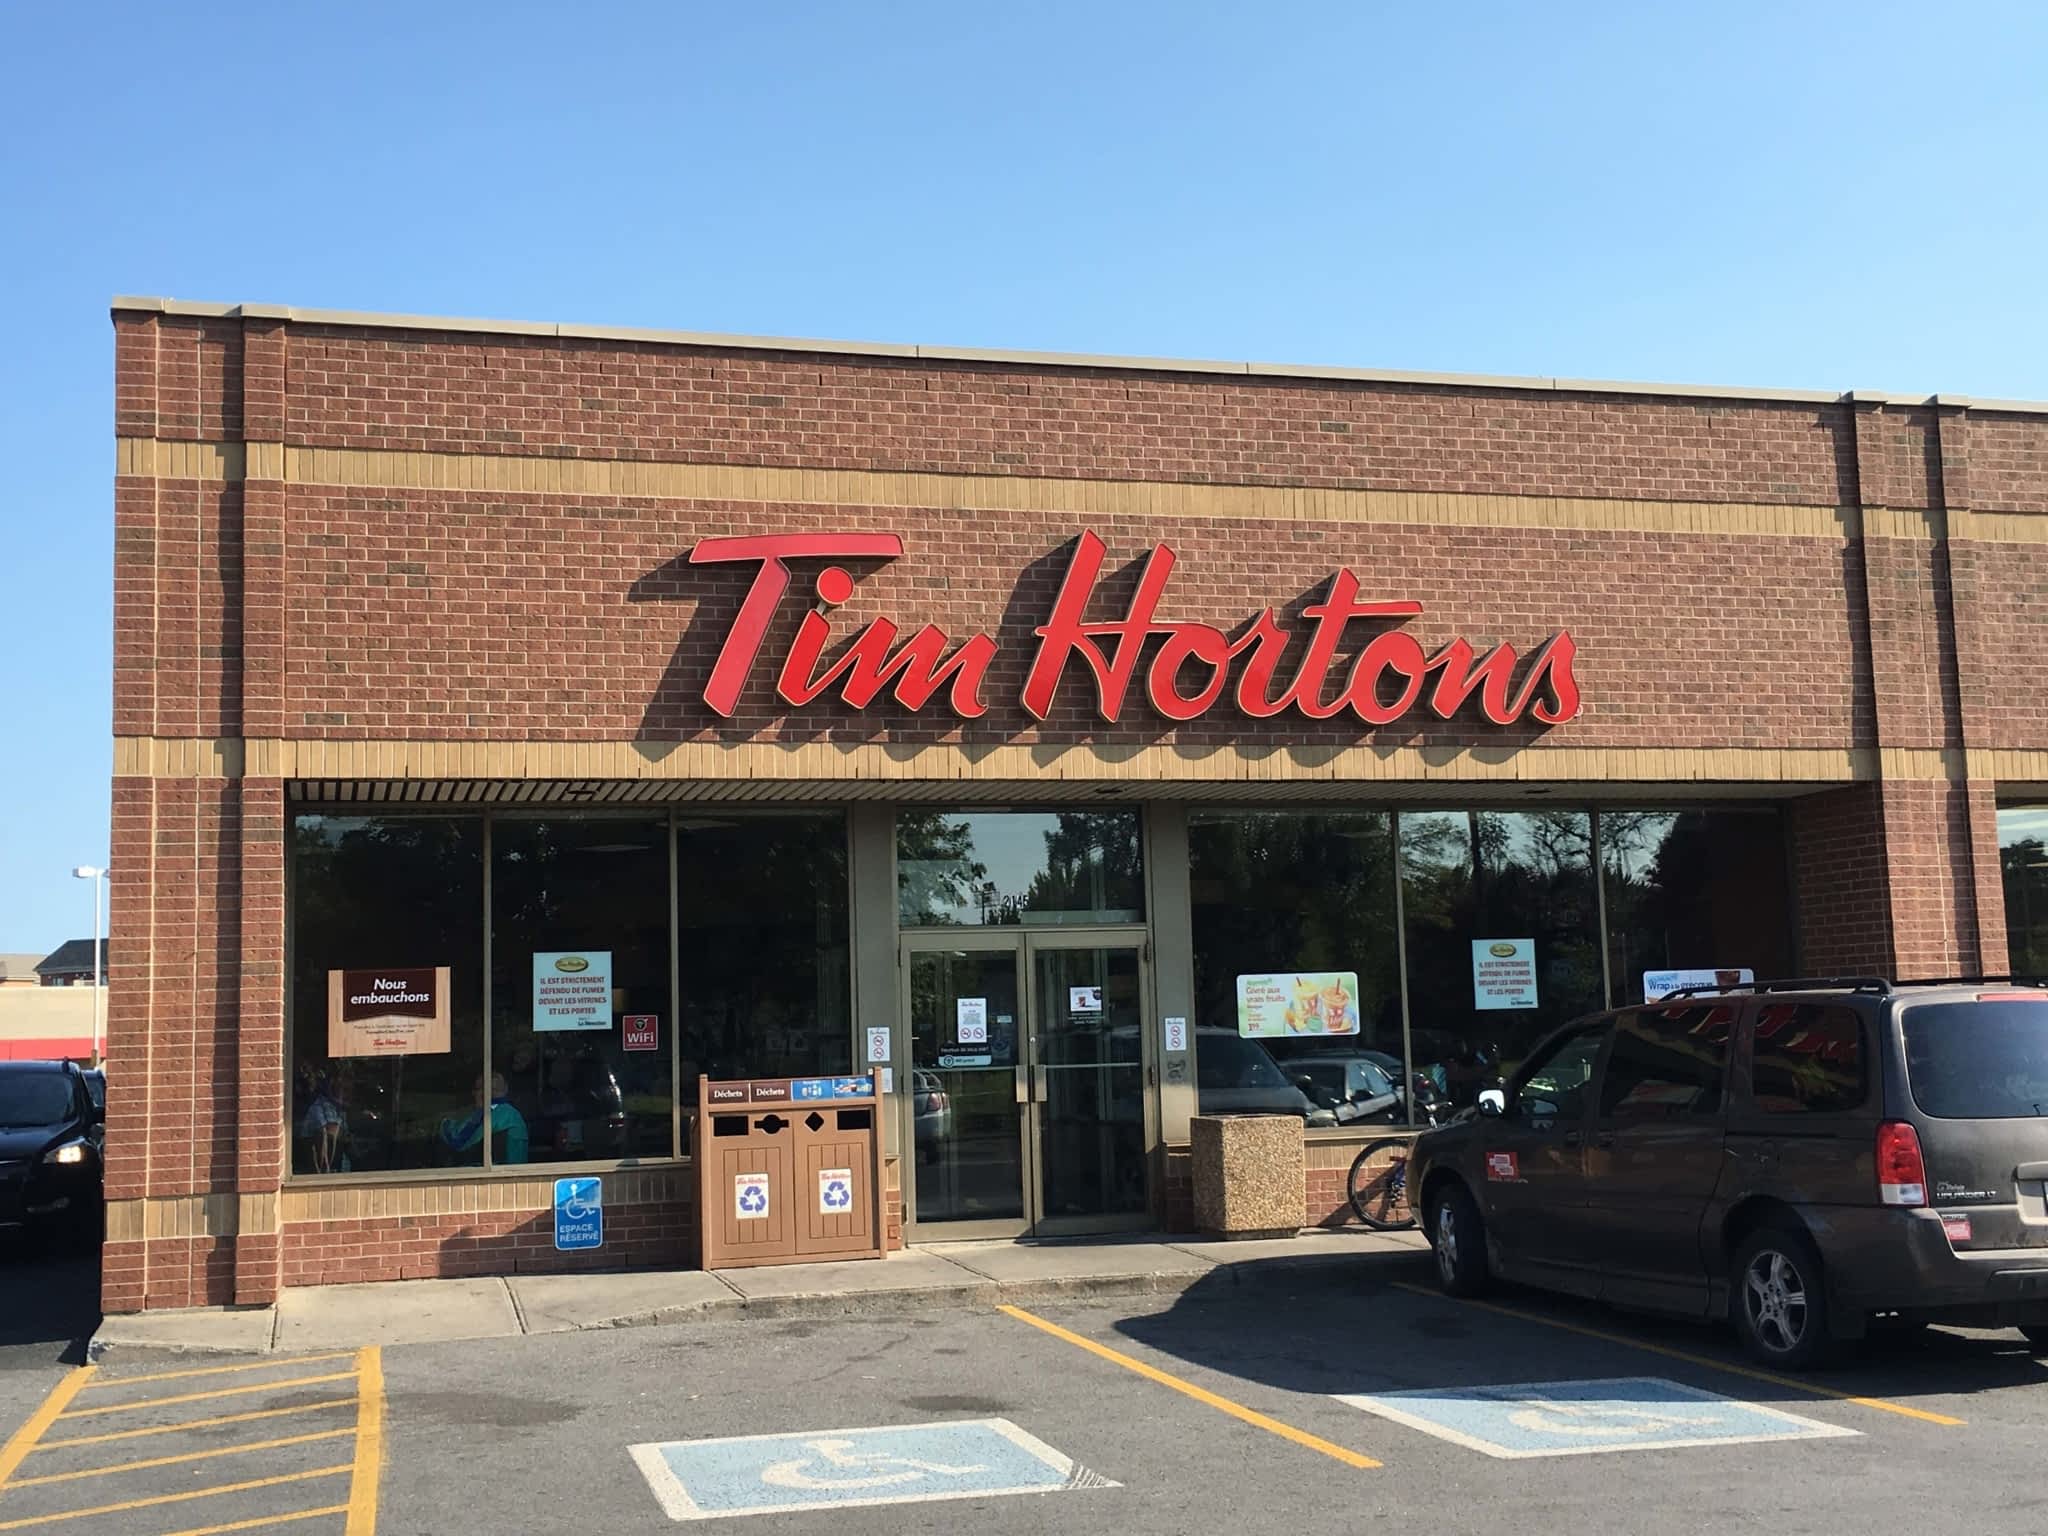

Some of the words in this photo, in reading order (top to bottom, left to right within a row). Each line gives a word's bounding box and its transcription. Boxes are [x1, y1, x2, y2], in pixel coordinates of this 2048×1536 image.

[688, 532, 999, 718] Tim
[1020, 528, 1581, 726] Hortons
[373, 979, 407, 990] Nous
[1648, 980, 1670, 991] Wrap
[350, 991, 430, 1004] embauchons
[627, 1032, 654, 1043] WiFi
[714, 1089, 743, 1098] Déchets
[756, 1088, 785, 1096] Déchets
[560, 1223, 594, 1233] ESPACE
